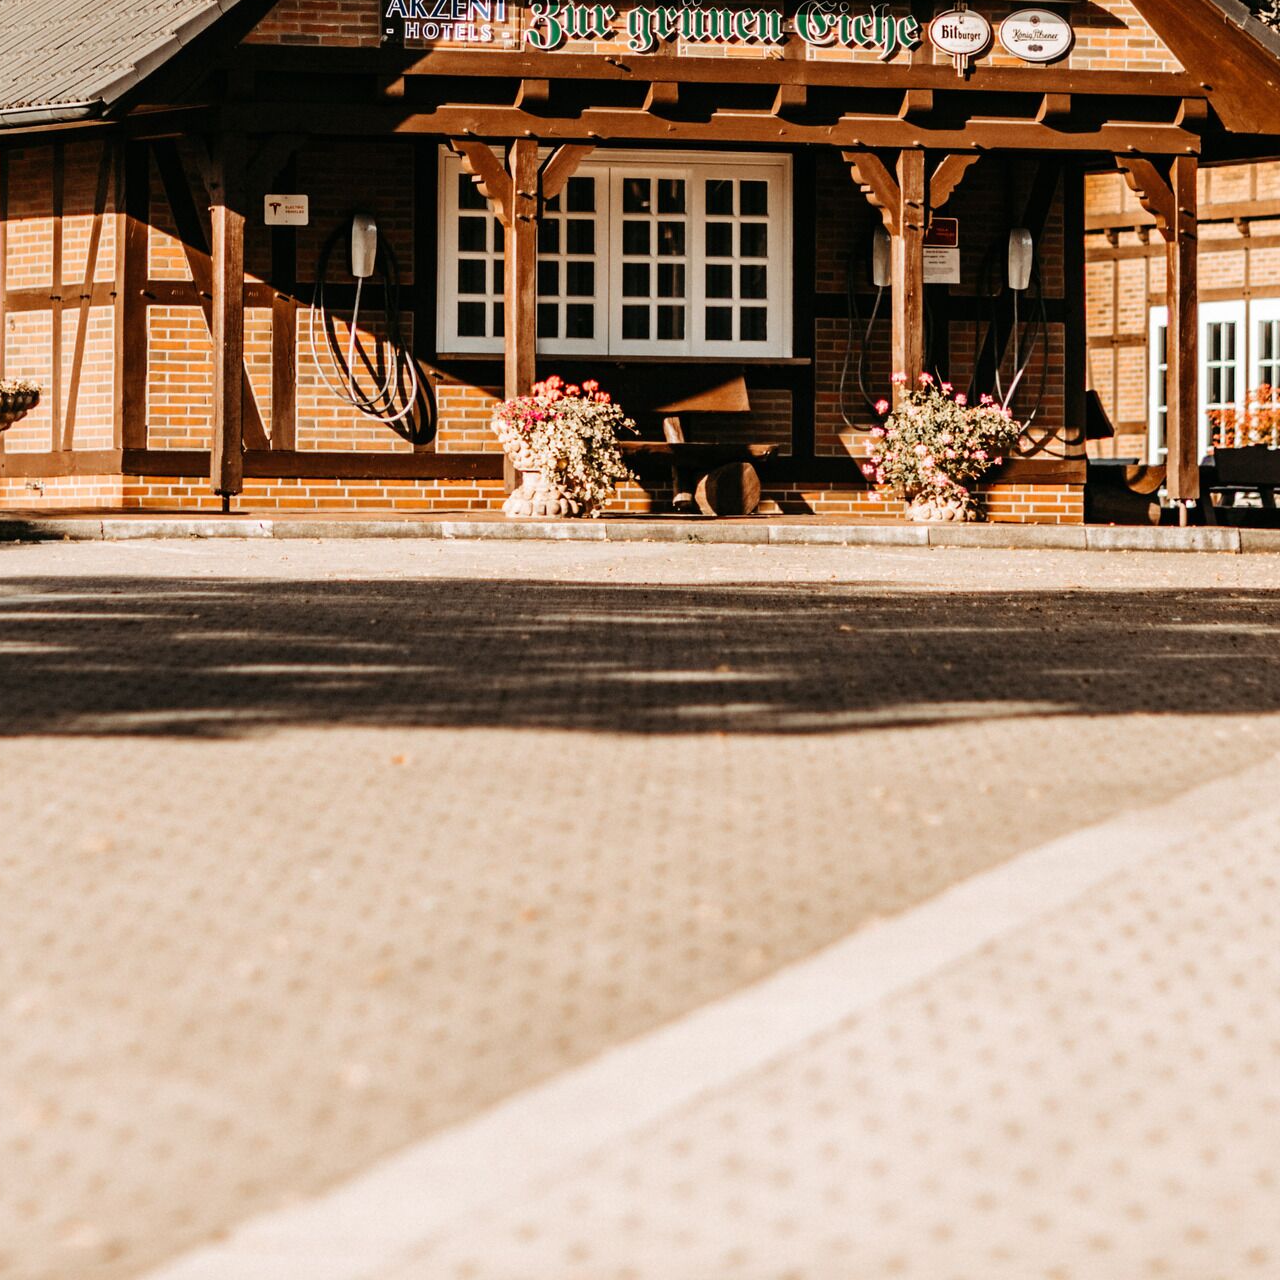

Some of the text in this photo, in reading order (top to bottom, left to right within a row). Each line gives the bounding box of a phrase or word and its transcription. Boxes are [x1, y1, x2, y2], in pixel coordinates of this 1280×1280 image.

[404, 21, 493, 42] HOTELS
[794, 0, 920, 61] Eiche
[941, 24, 981, 42] Bitburger
